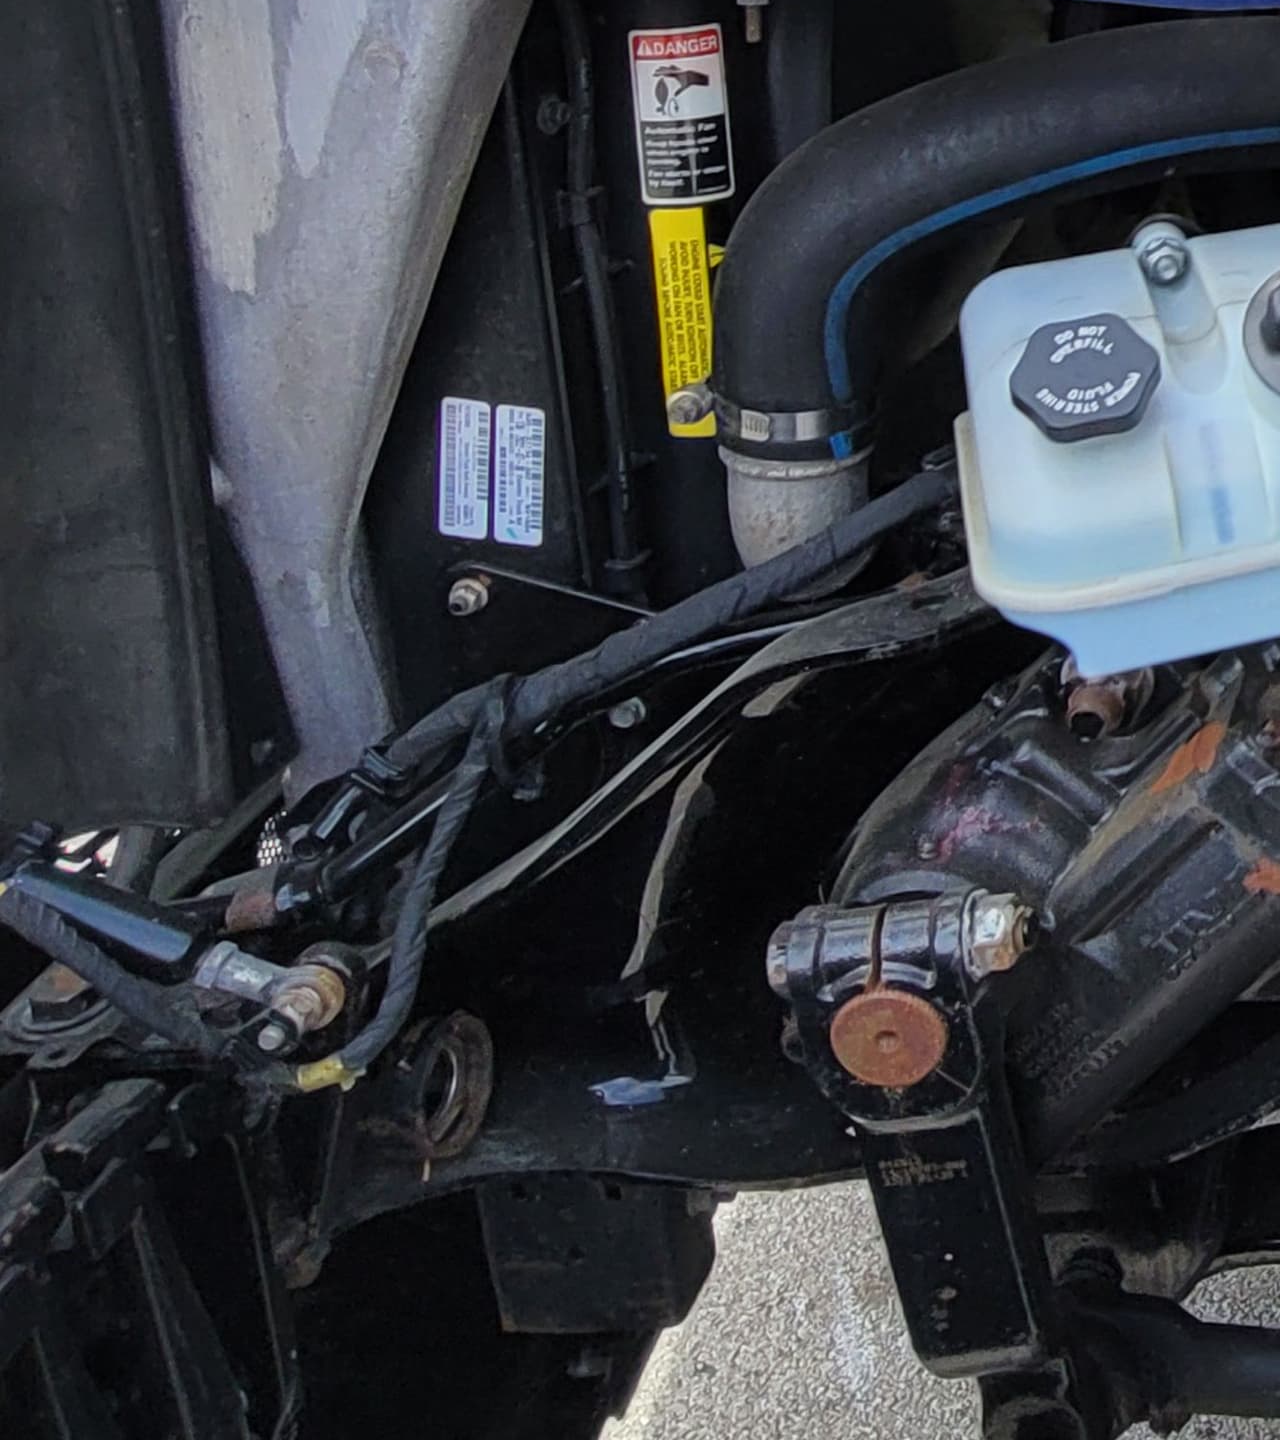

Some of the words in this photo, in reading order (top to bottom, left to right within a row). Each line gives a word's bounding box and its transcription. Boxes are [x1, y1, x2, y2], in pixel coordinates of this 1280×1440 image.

[653, 35, 718, 56] DANGER
[1053, 329, 1075, 345] DO
[1078, 325, 1108, 337] NOT
[1049, 336, 1115, 364] OVERFILL
[1035, 388, 1100, 415] STEERING
[1066, 381, 1115, 401] FLUID
